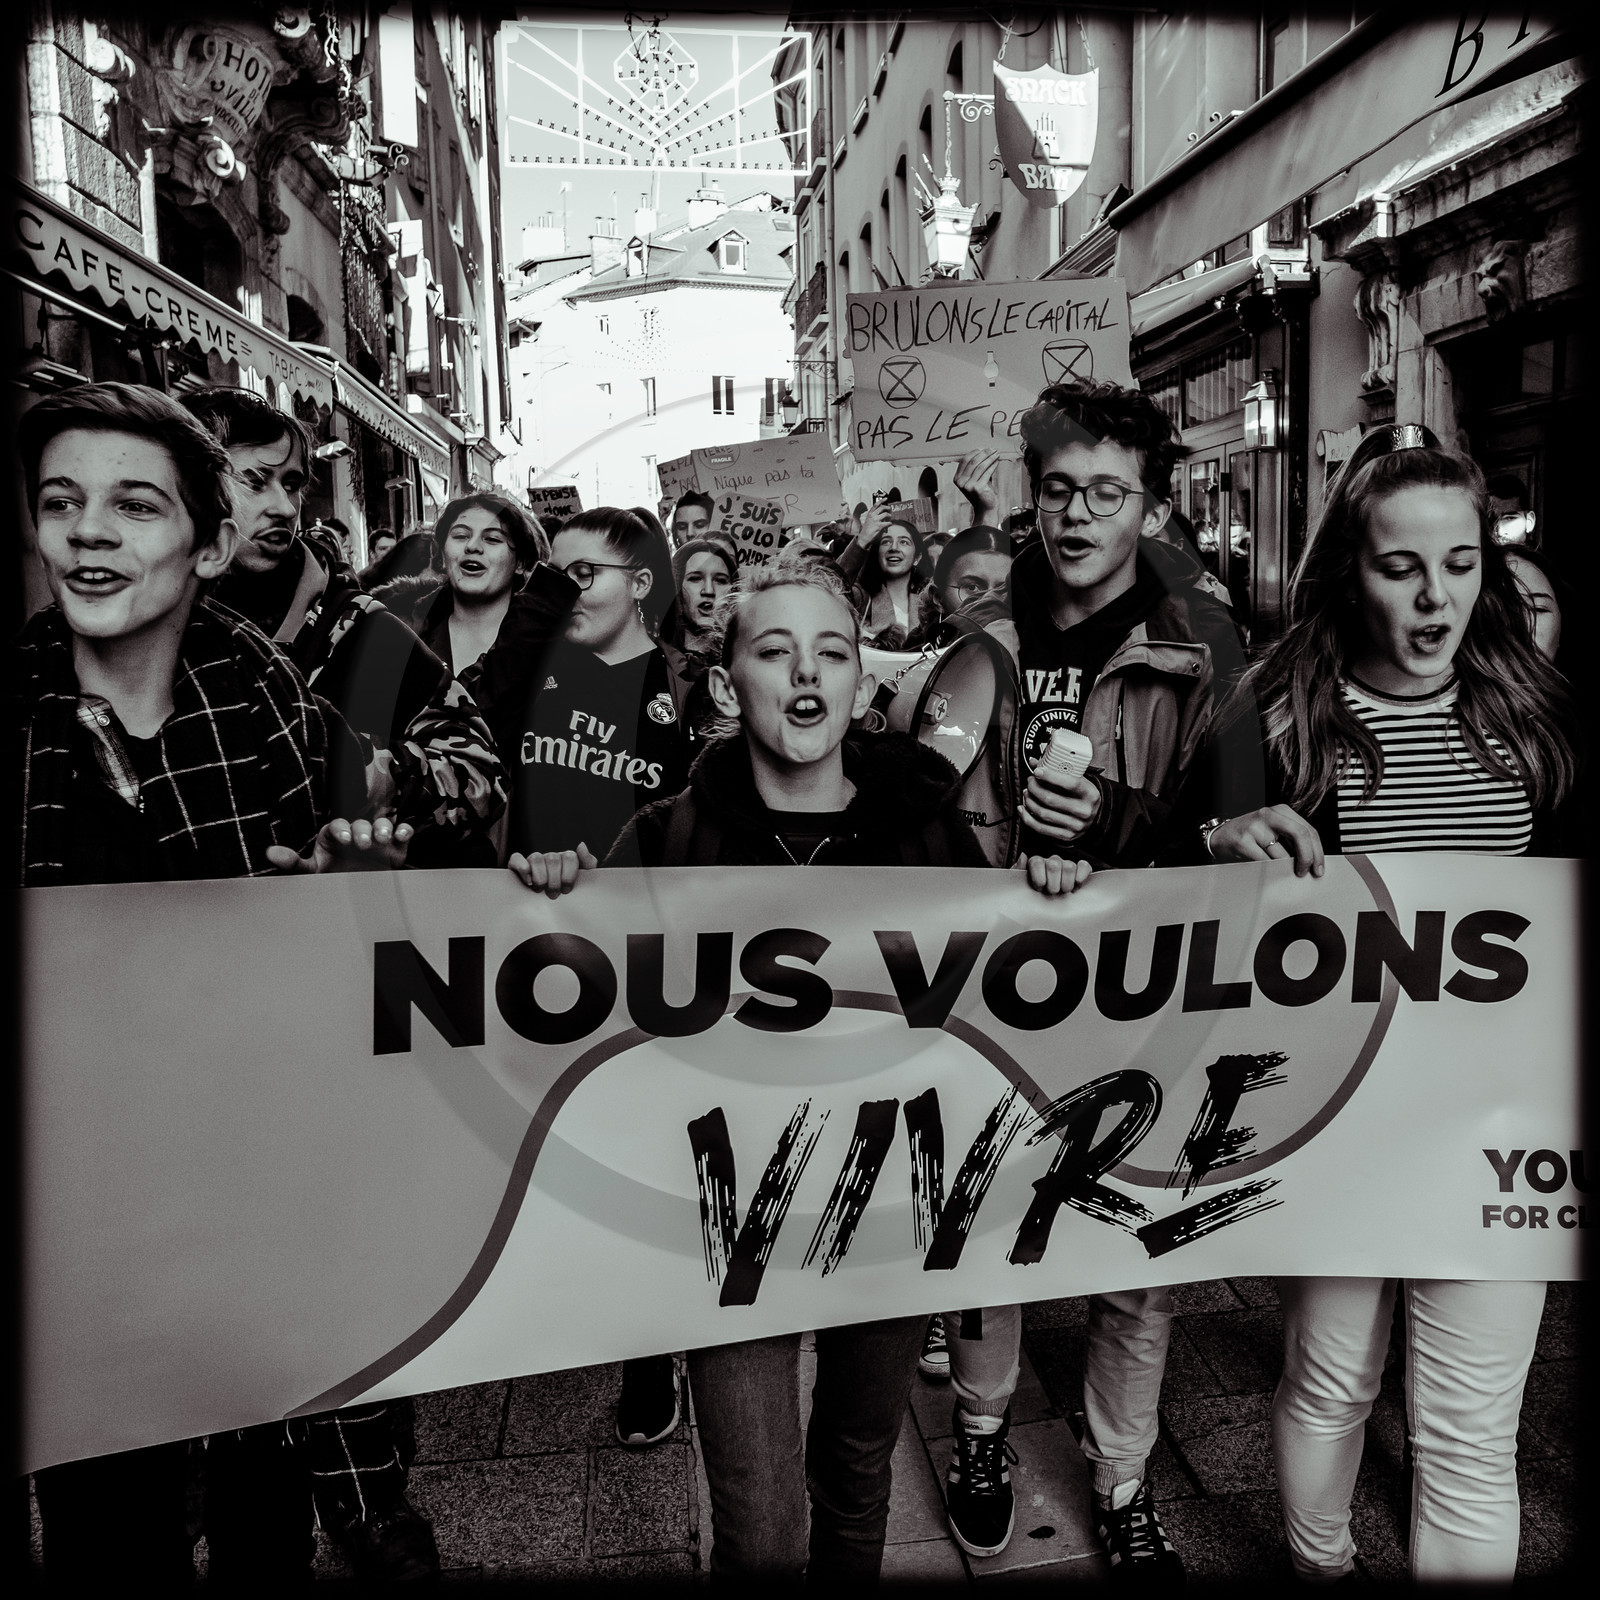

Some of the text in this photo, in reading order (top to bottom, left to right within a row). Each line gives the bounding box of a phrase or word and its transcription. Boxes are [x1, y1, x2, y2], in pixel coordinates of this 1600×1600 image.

[1005, 77, 1087, 106] SNACK
[1018, 163, 1073, 191] BAR
[850, 295, 987, 352] BRULONS
[987, 298, 1026, 339] LE
[268, 350, 301, 387] TABAC
[857, 404, 1032, 449] PAS LE PE
[711, 456, 732, 464] FRAGILE
[714, 465, 815, 493] Nique pas ta
[720, 514, 774, 548] ÉCOLO
[1024, 666, 1082, 704] VER
[569, 709, 617, 744] Fly
[1025, 711, 1078, 750] STUDI UNIVE
[520, 731, 663, 789] Emirates
[373, 909, 1532, 1056] NOUS VOULONS
[687, 1050, 1290, 1308] VIVRE
[1482, 1204, 1550, 1229] FOR
